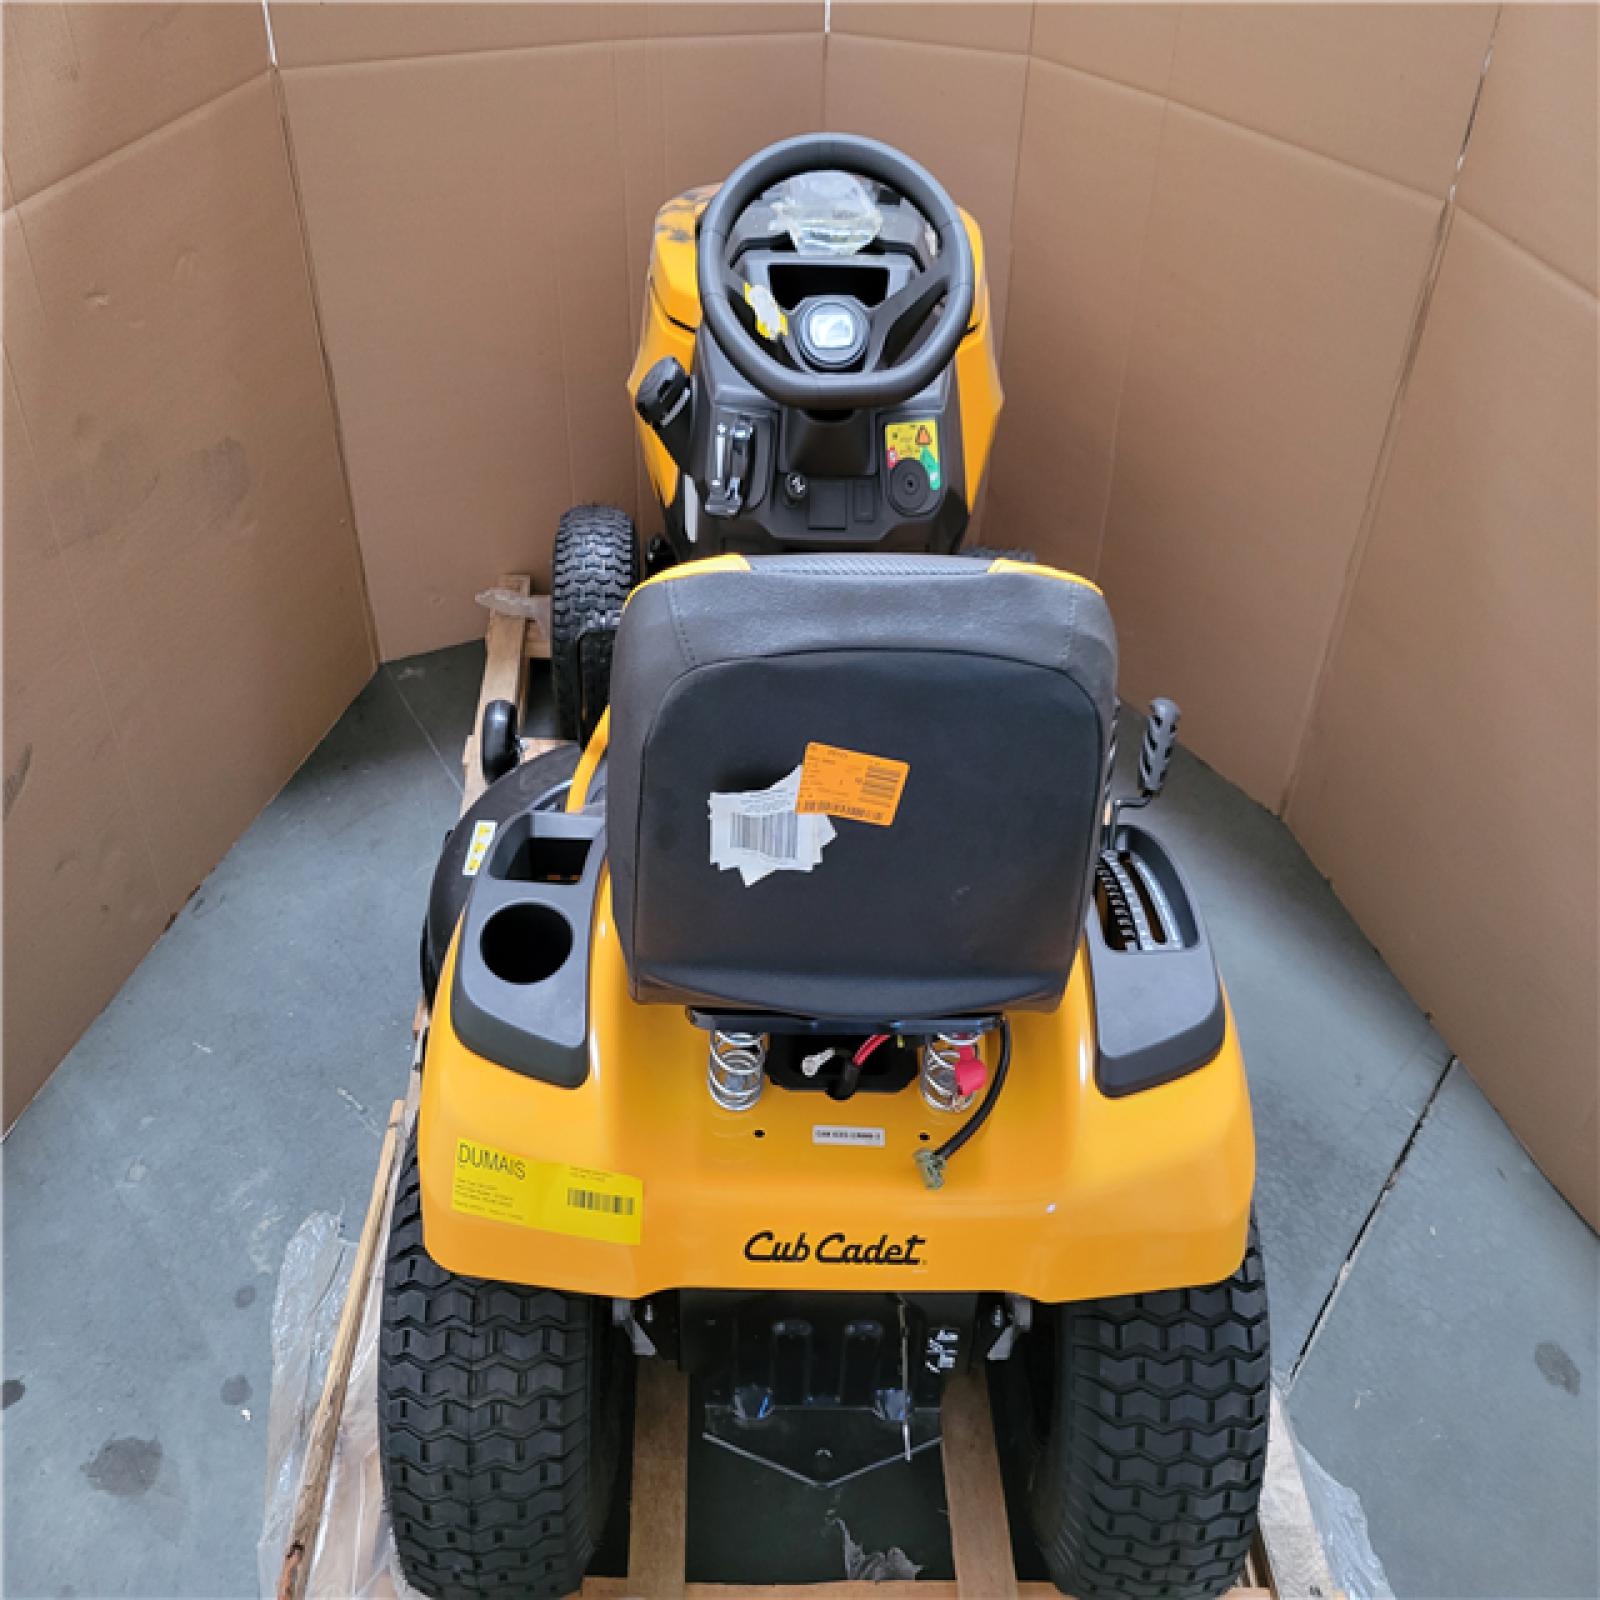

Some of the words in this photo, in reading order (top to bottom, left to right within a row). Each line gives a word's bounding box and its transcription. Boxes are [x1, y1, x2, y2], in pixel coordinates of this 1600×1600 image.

[457, 1142, 526, 1181] DUMAIS
[744, 1230, 811, 1262] Cub
[815, 1232, 926, 1265] Cadet
